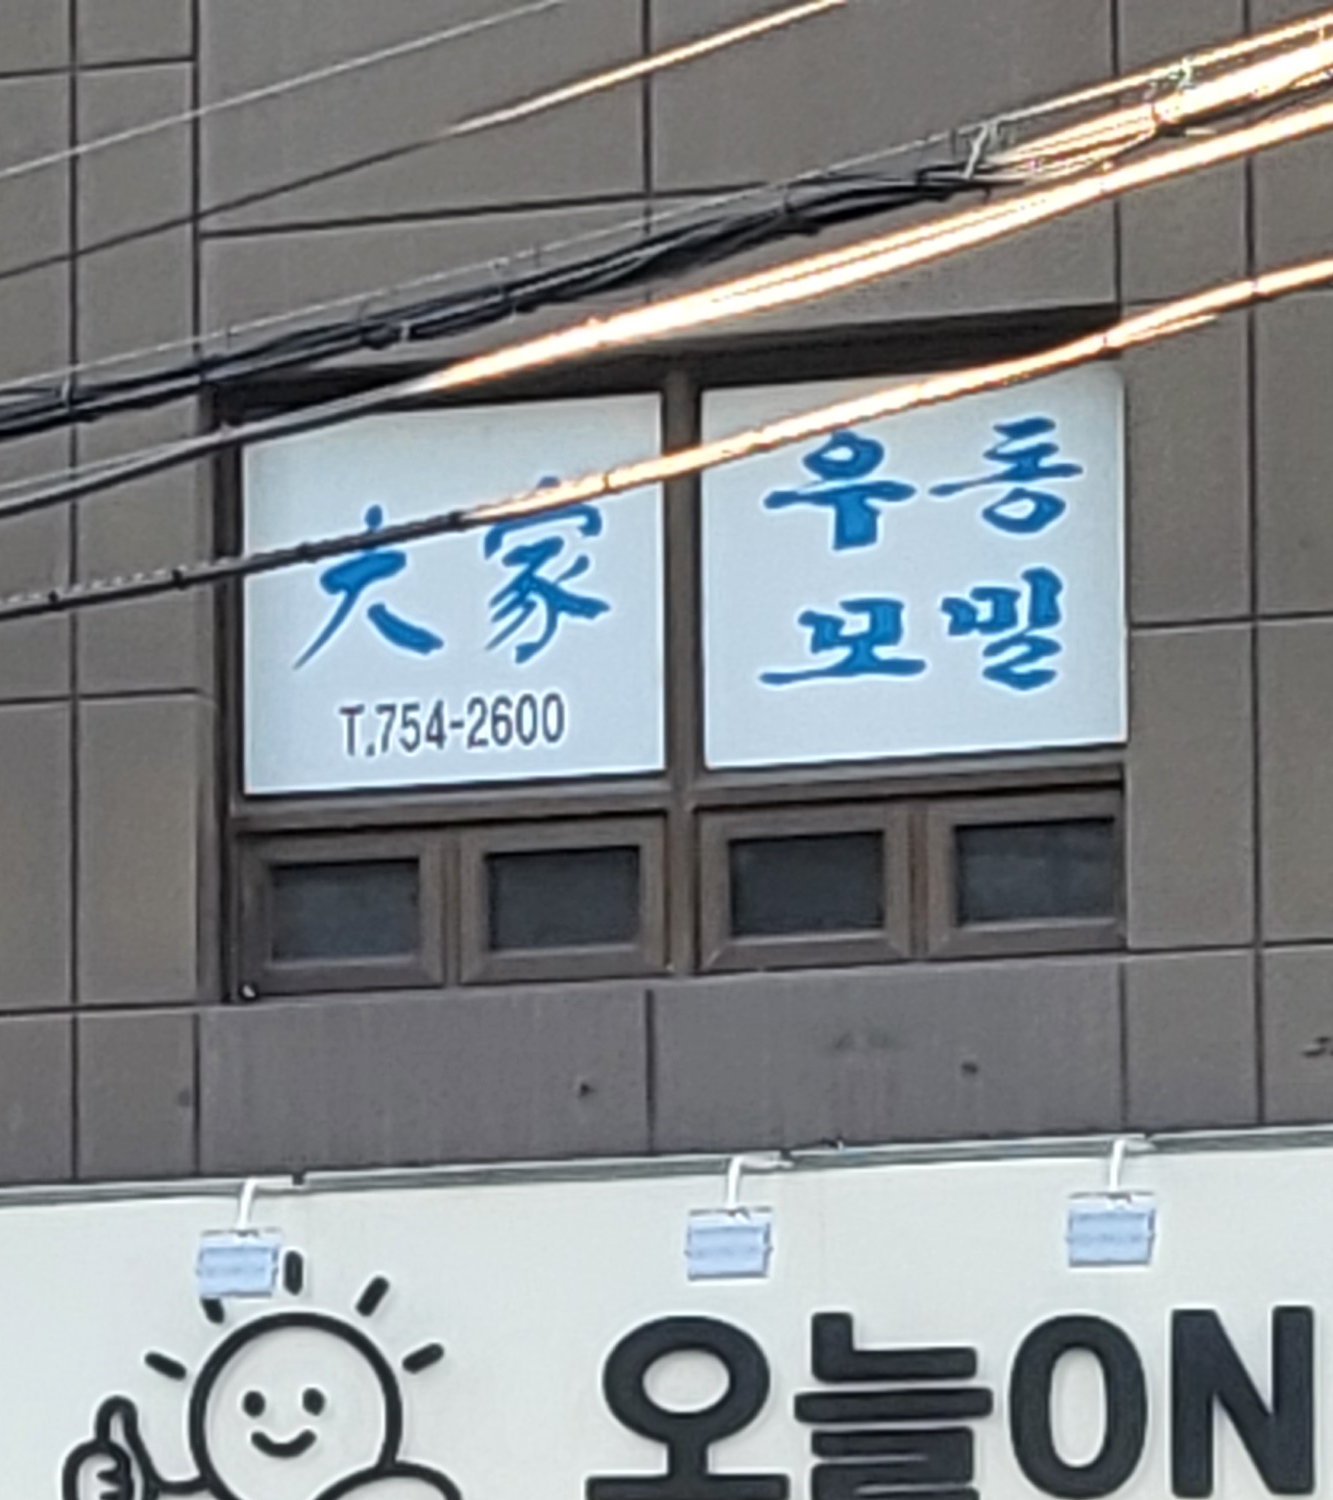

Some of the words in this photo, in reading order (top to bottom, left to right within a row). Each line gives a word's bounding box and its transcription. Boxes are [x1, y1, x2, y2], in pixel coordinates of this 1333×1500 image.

[762, 415, 1085, 553] 우동
[292, 476, 612, 670] 大家
[758, 566, 1064, 692] 모밀
[339, 693, 566, 759] T.754-2600
